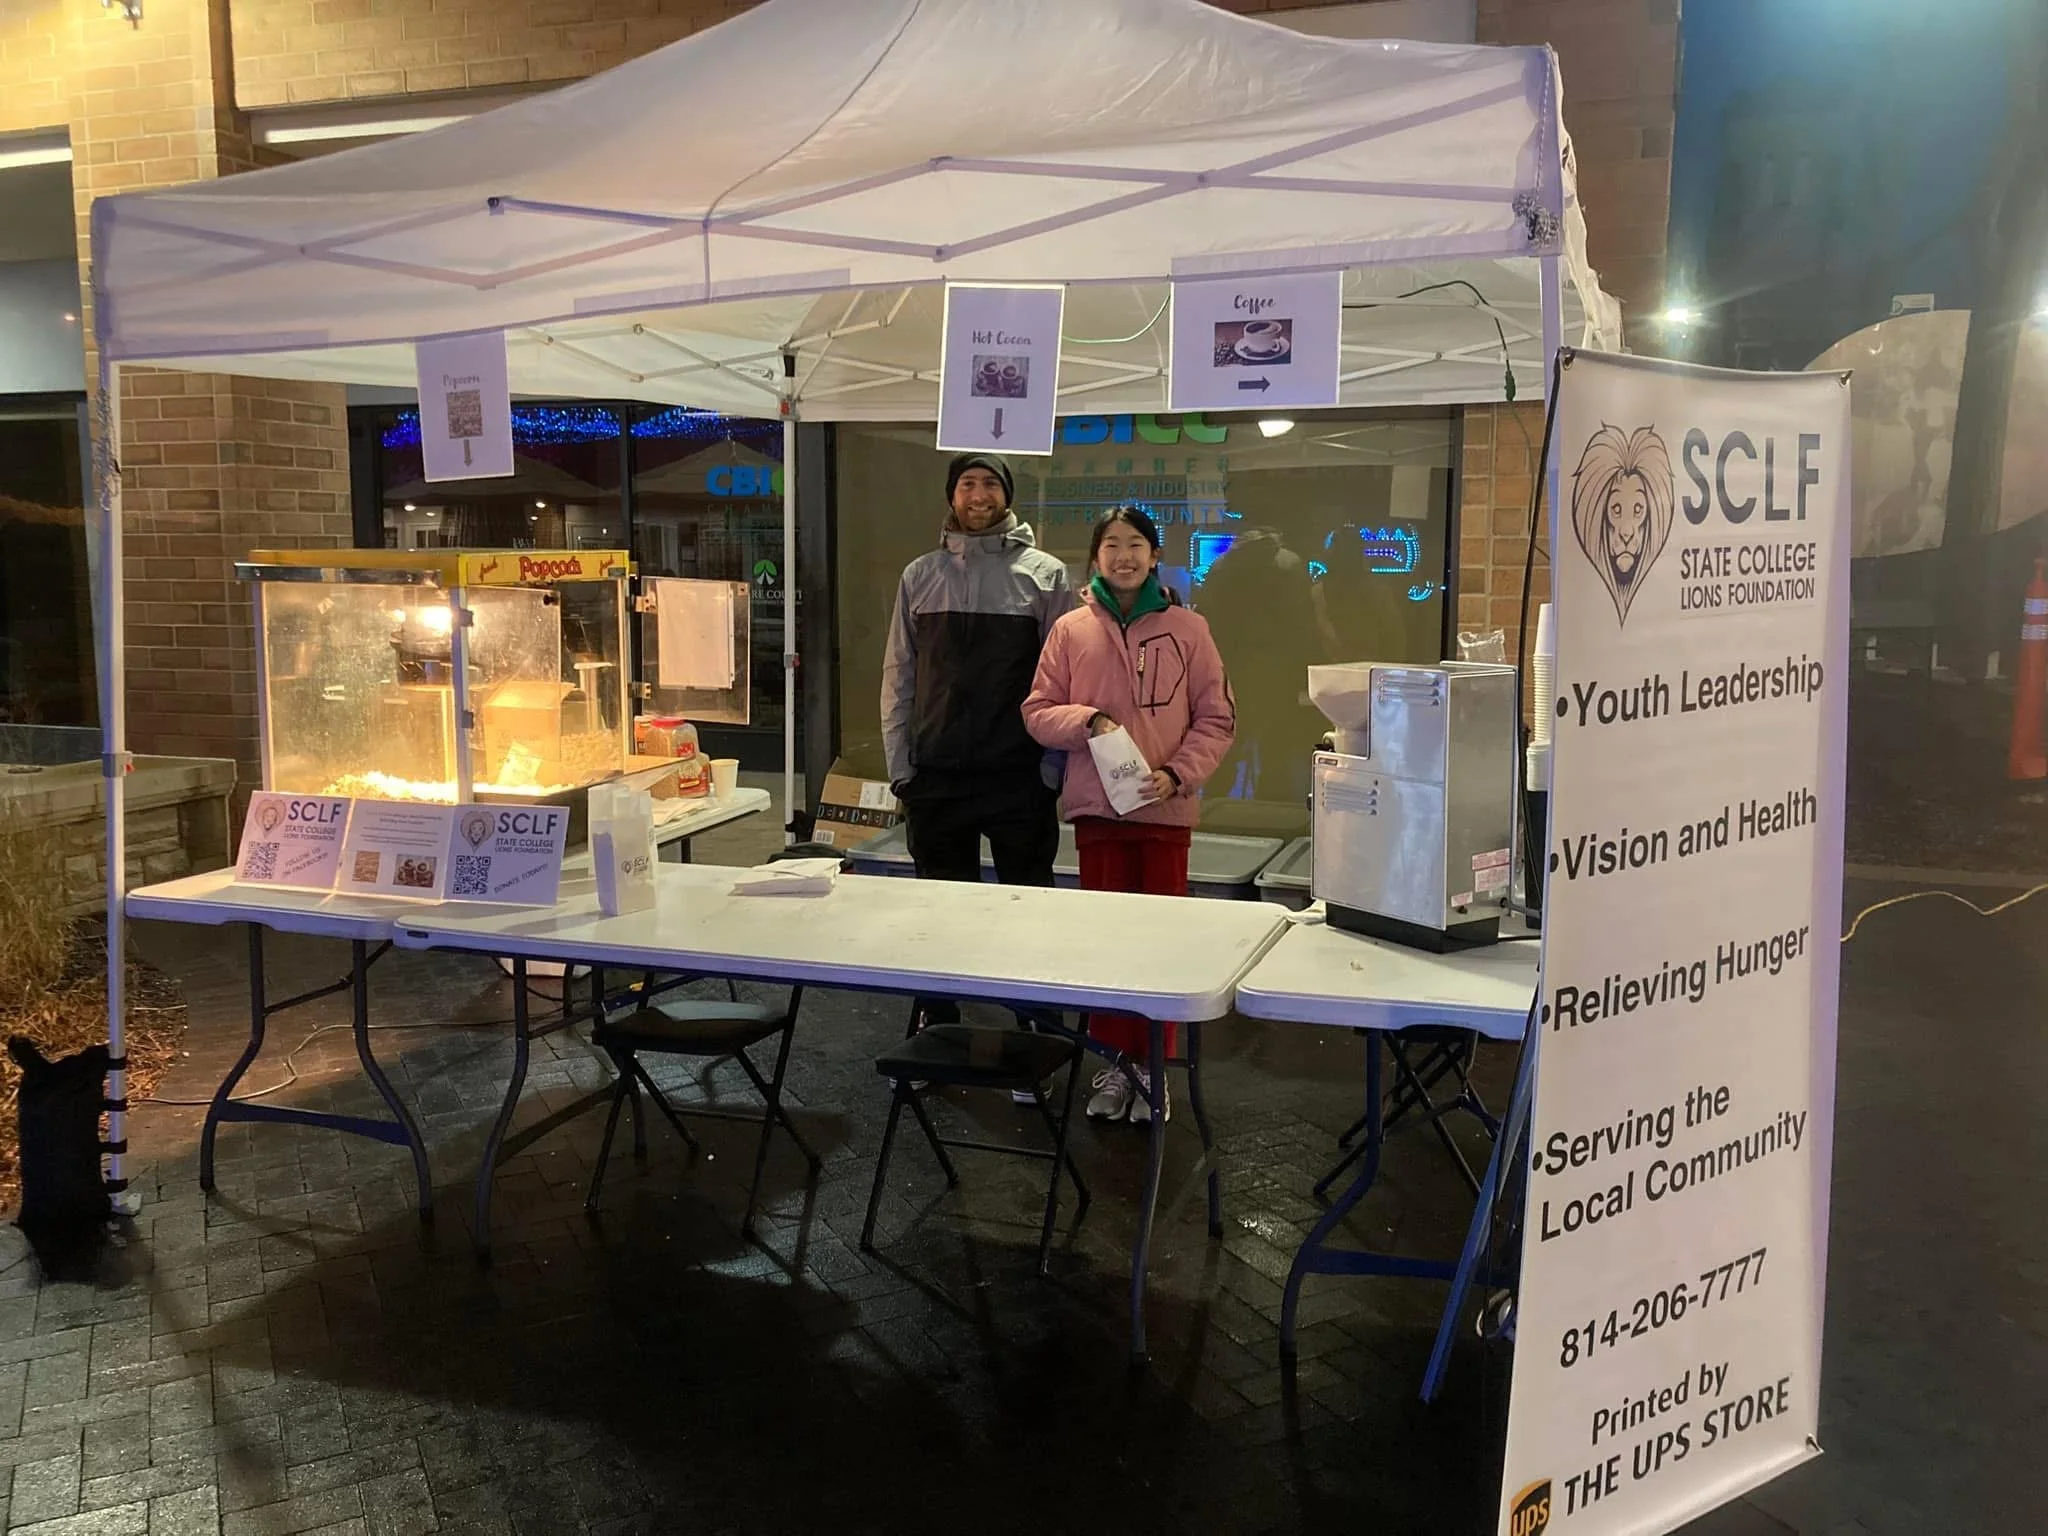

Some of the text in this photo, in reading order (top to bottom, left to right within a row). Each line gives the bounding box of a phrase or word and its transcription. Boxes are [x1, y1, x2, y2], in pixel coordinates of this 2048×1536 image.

[972, 330, 993, 345] Hot
[1234, 294, 1276, 313] Coffee
[1681, 427, 1821, 525] SCLF
[1681, 543, 1816, 579] STATE COLLEGE
[1681, 578, 1815, 610] LIONS FOUNDATION
[1572, 654, 1823, 727] Youth Leadership
[288, 801, 342, 823] SCLF
[498, 812, 557, 835] SCLF
[1562, 828, 1668, 881] Vision
[1678, 806, 1729, 857] and
[1738, 787, 1817, 842] Health
[1553, 926, 1809, 1032] Relieving Hunger
[1544, 1085, 1729, 1176] Serving the
[1540, 1111, 1807, 1242] Local Community
[1560, 1247, 1766, 1368] 814-206-7777
[1591, 1362, 1729, 1446] Printed by
[1564, 1455, 1621, 1517] THE
[1633, 1422, 1690, 1480] UPS
[1701, 1376, 1790, 1448] STORE
